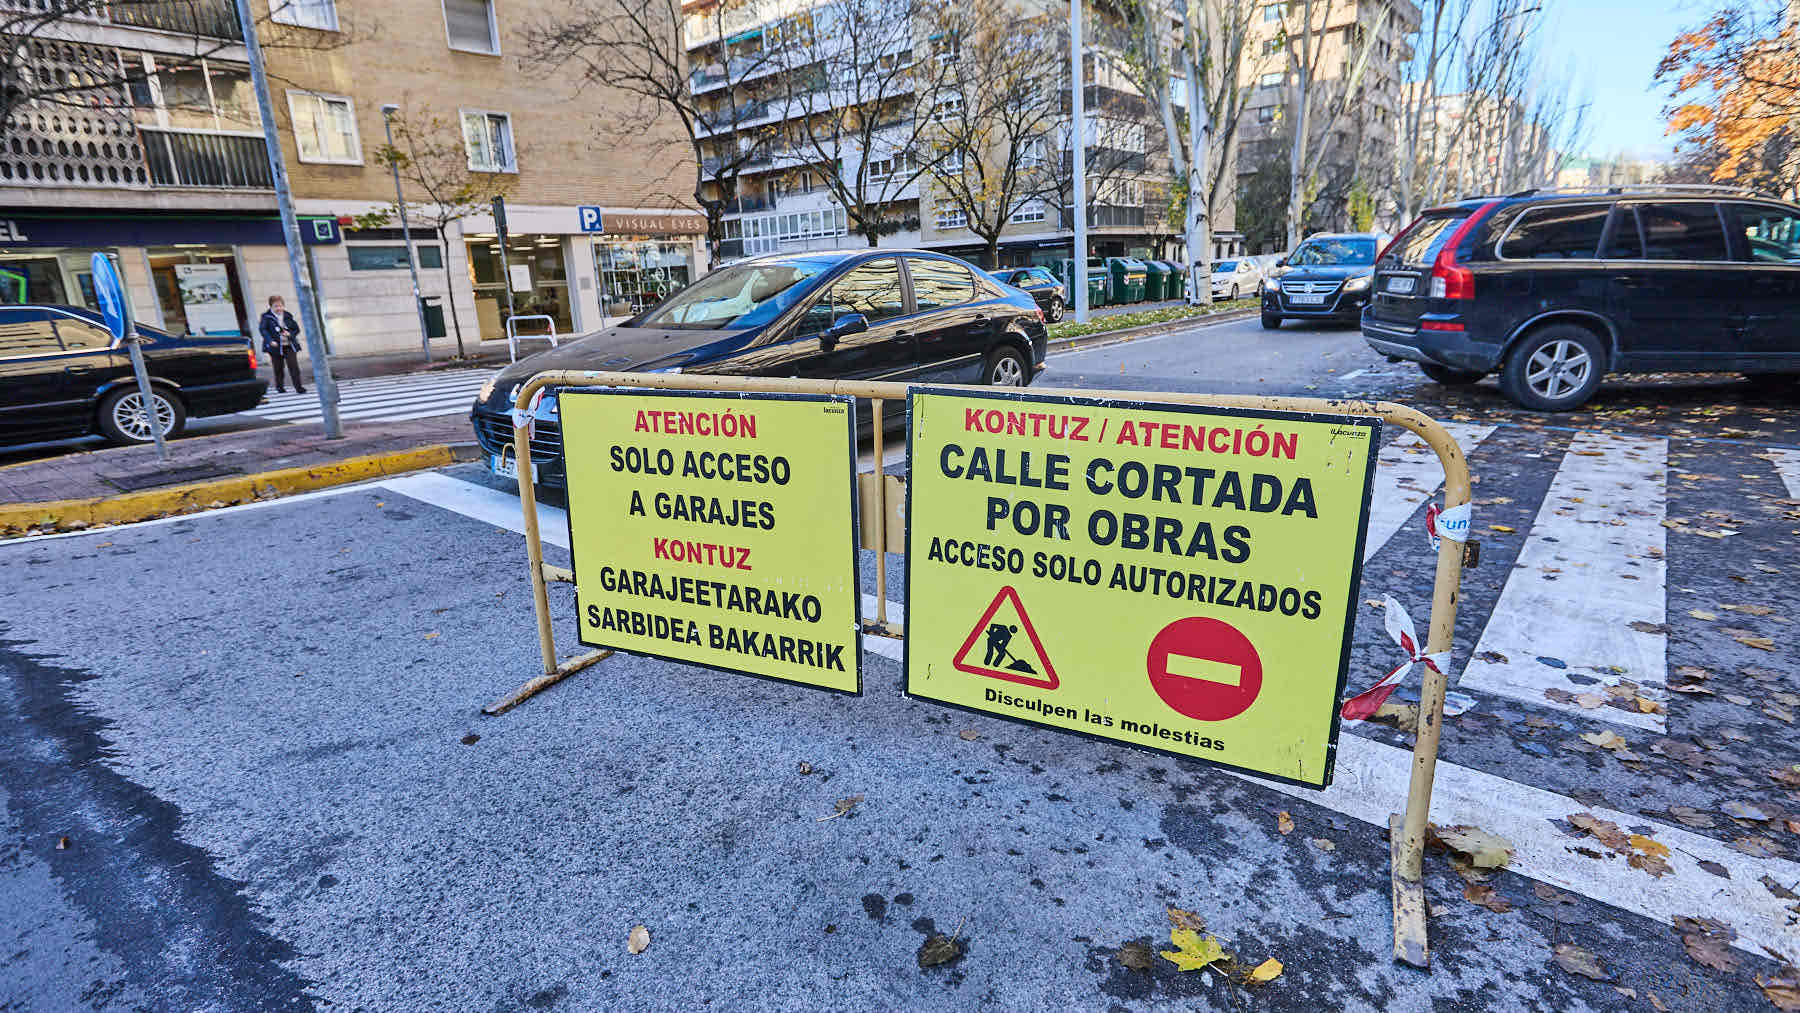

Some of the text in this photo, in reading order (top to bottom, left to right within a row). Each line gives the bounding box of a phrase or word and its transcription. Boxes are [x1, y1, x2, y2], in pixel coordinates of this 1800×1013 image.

[583, 208, 597, 229] P
[616, 219, 700, 230] VISUAL EYES
[634, 408, 757, 438] ATENCIÓN
[965, 408, 1299, 460] KONTUZ / ATENCIÓN
[611, 446, 791, 486] SOLO ACCESO
[940, 444, 1318, 519] CALLE CORTADA
[630, 490, 776, 530] A GARAJES
[987, 496, 1252, 564] POR OBRAS
[654, 537, 752, 571] KONTUZ
[928, 537, 1323, 620] ACCESO SOLO AUTORIZADOS
[600, 567, 822, 623] GARAJEETARAKO
[588, 604, 846, 673] SARBIDEA BAKARRIK
[985, 687, 1226, 751] Disculpen las molestias
